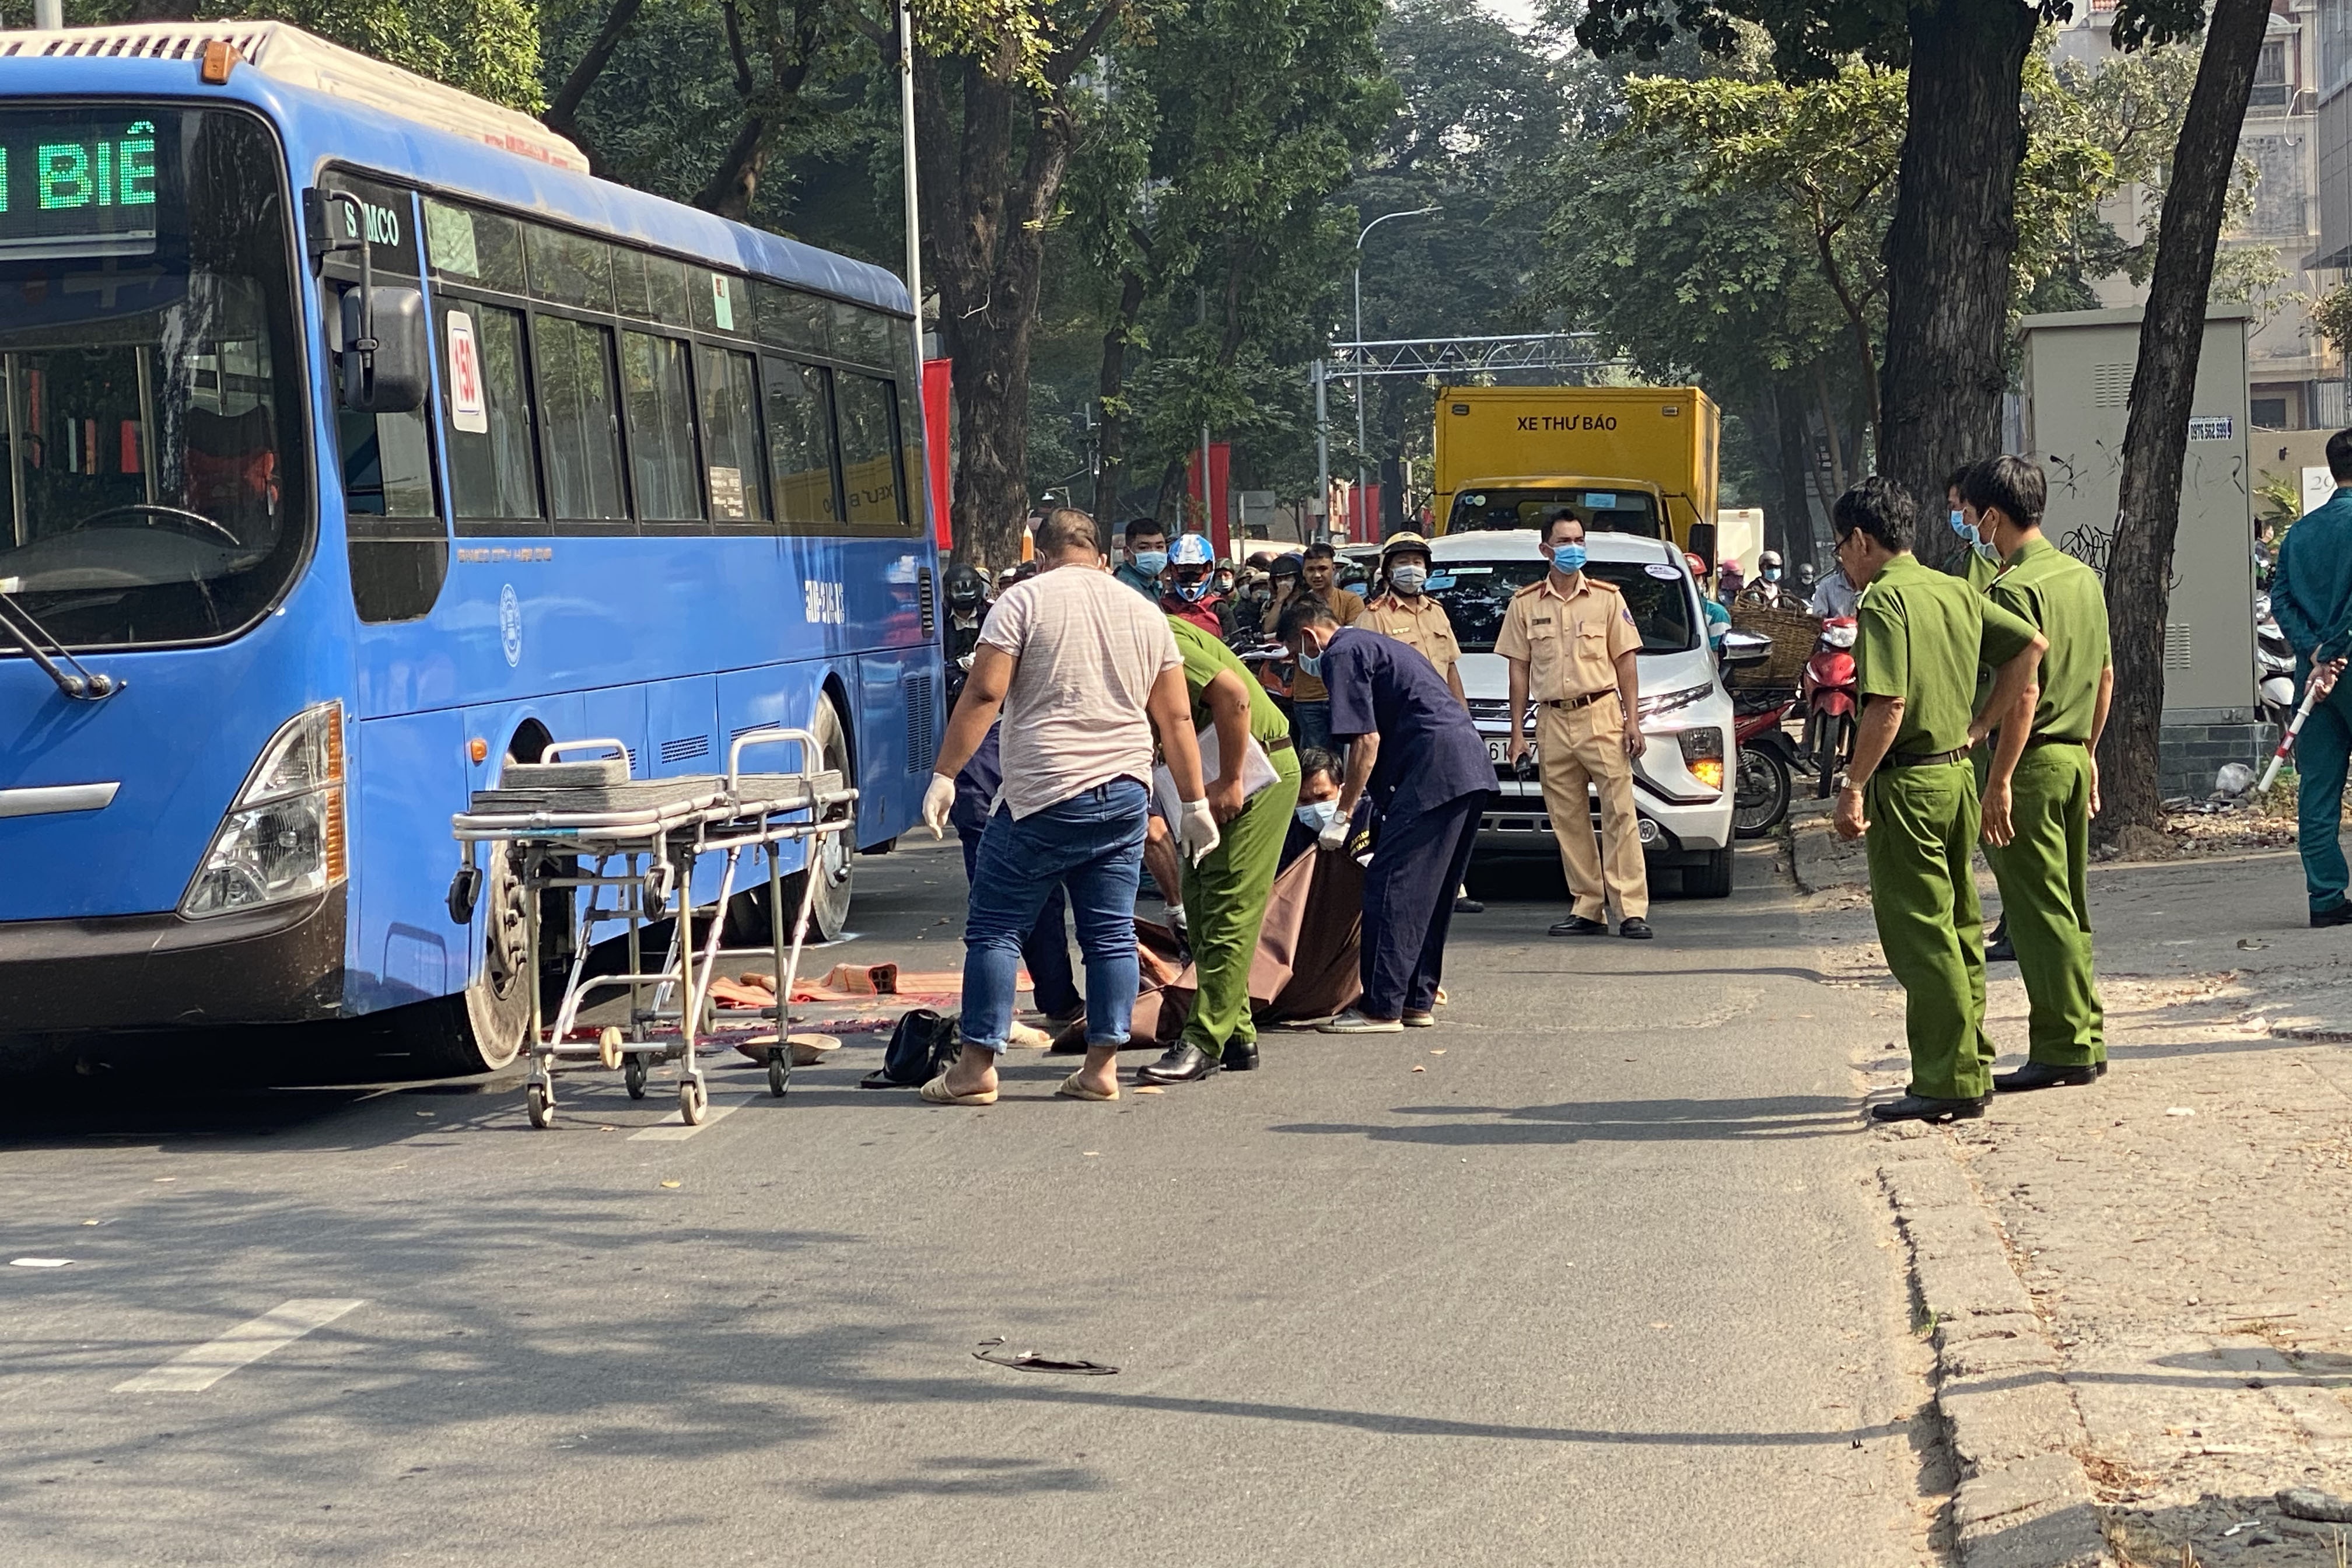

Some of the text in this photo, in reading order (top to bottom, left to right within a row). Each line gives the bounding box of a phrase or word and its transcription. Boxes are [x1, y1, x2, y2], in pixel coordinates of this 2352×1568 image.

[37, 121, 156, 209] BIÊ
[345, 201, 399, 246] SMCO
[1517, 414, 1617, 430] XE THƯ BÁO
